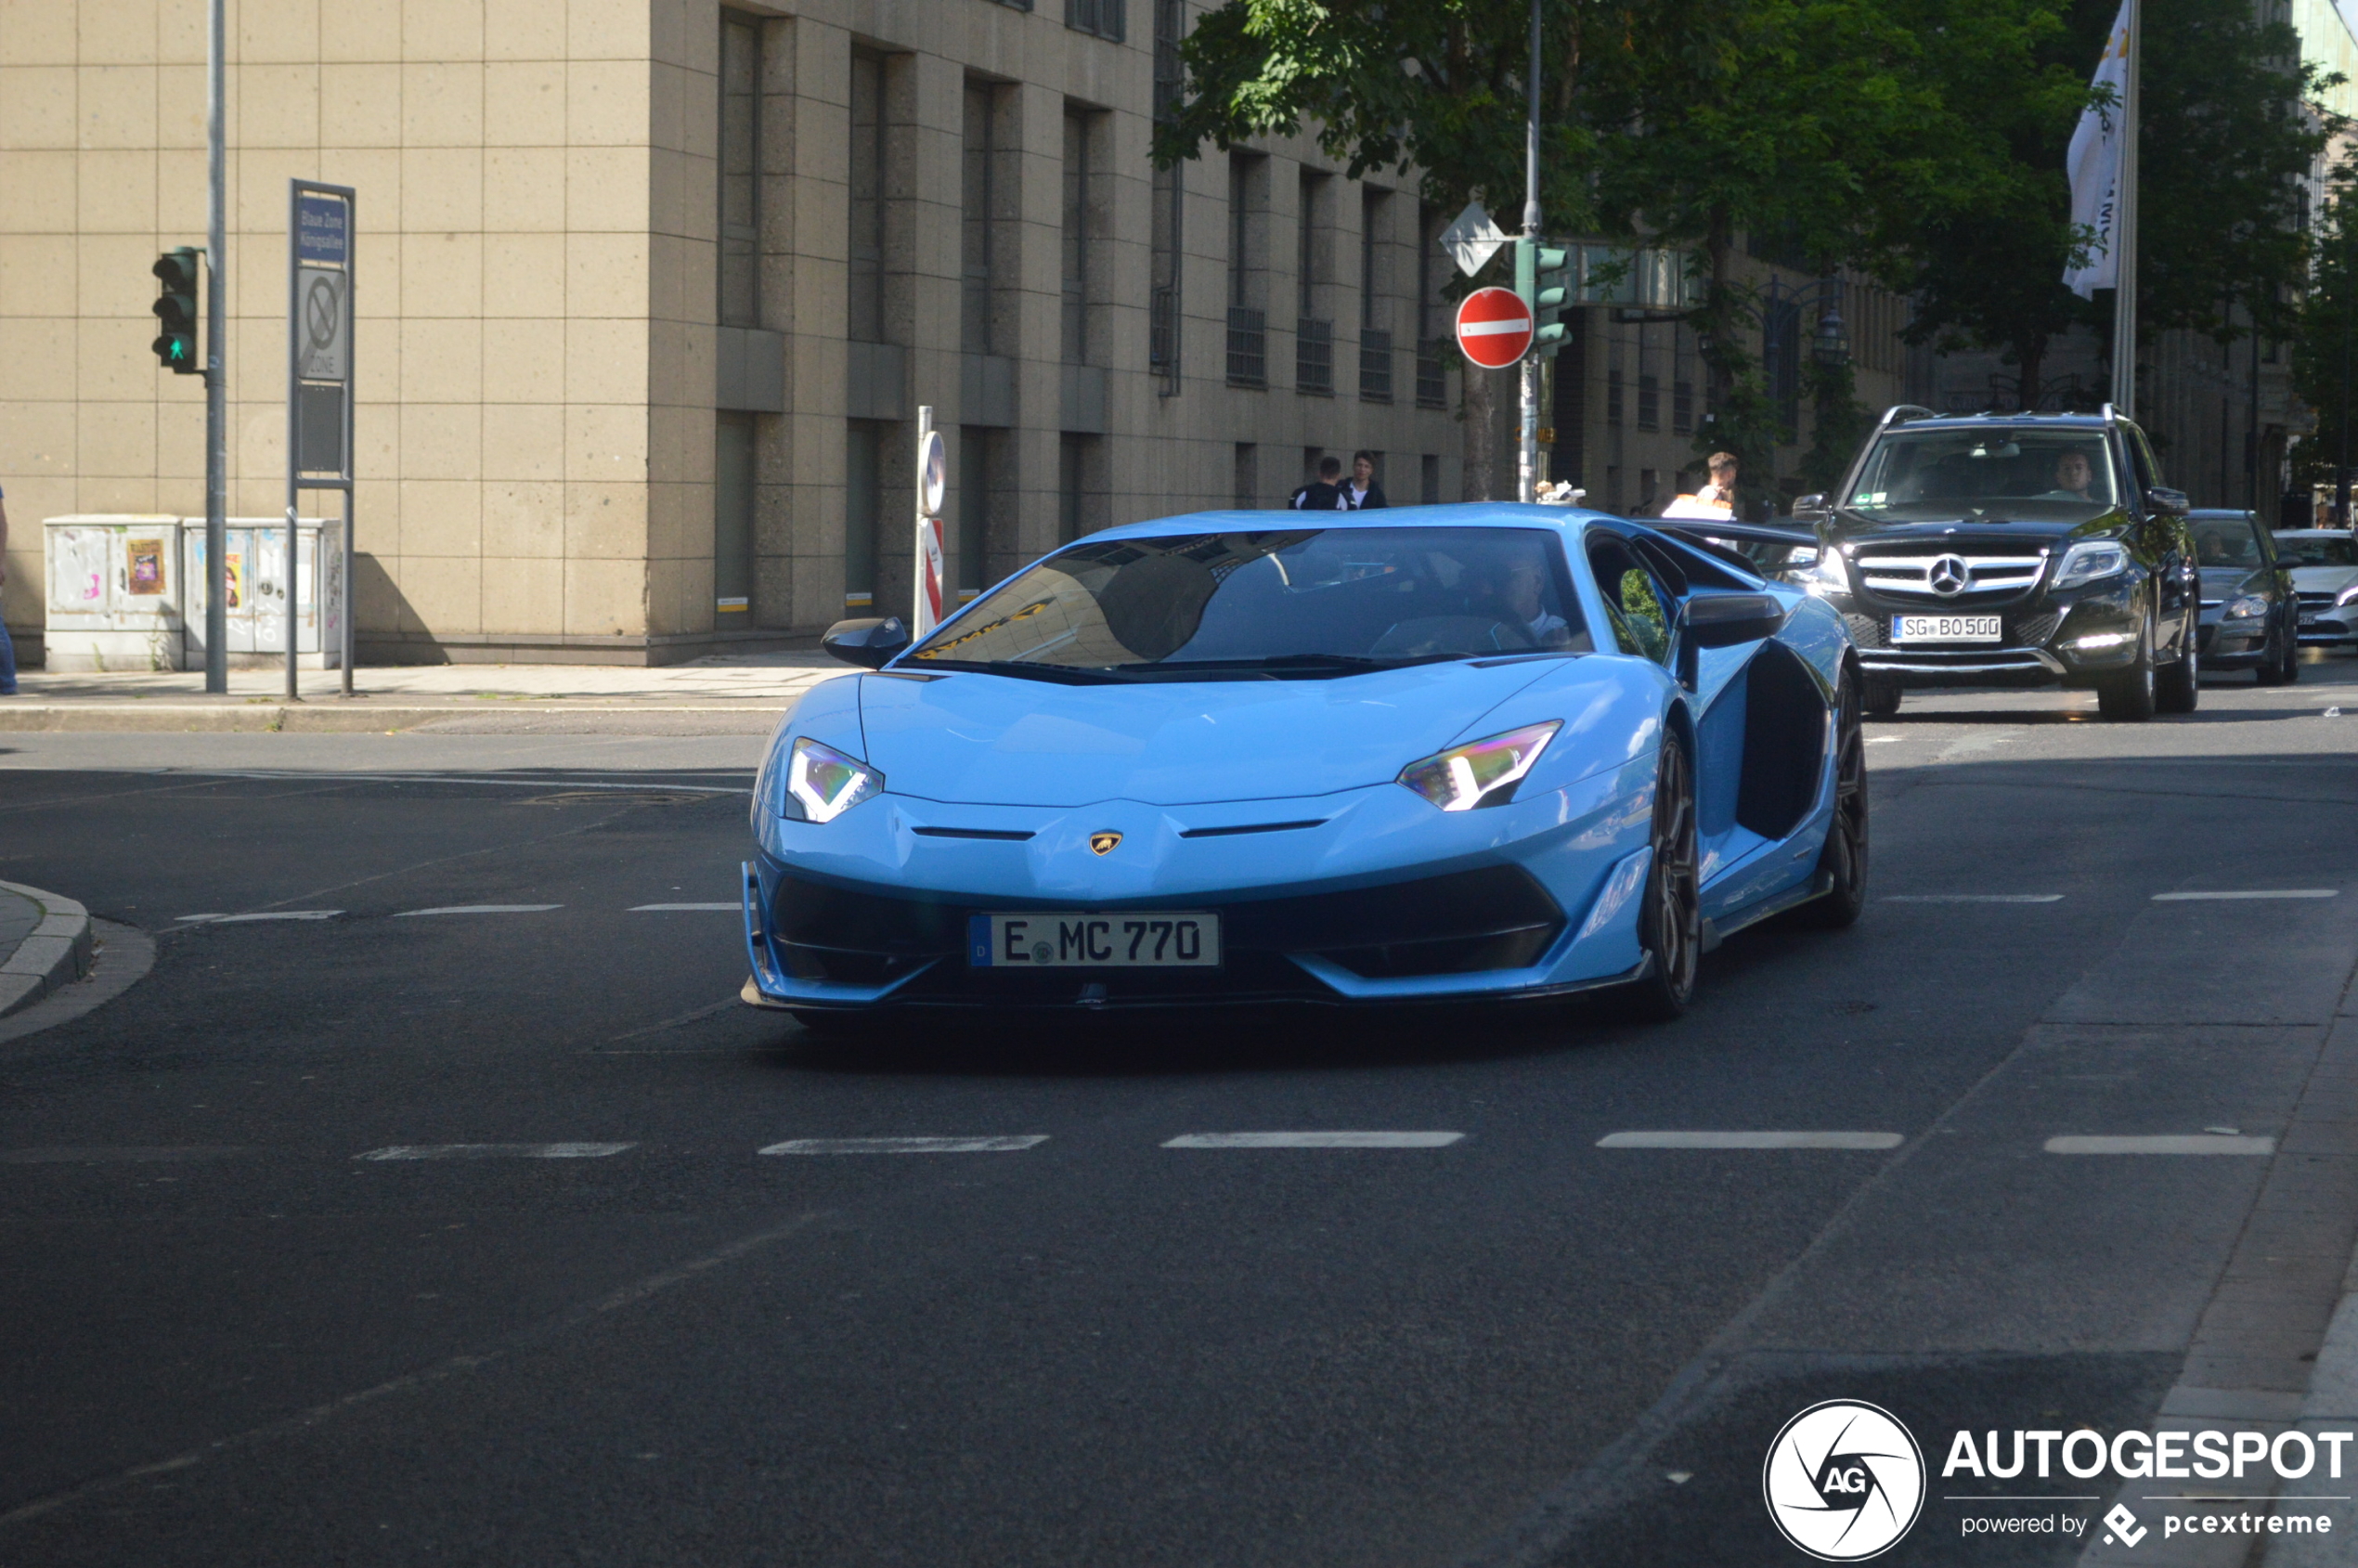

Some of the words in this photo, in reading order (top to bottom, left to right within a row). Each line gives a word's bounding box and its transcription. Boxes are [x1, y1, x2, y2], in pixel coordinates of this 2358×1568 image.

[301, 210, 323, 227] Blaue
[324, 211, 343, 229] Zone
[300, 231, 343, 252] Königsallee
[310, 356, 334, 373] ZONE
[1905, 618, 1927, 636] SG
[1939, 618, 1963, 636] BO
[1965, 618, 1999, 635] 500
[977, 945, 986, 957] D
[1005, 921, 1030, 961] E
[1059, 921, 1112, 961] MC
[1123, 920, 1200, 961] 770
